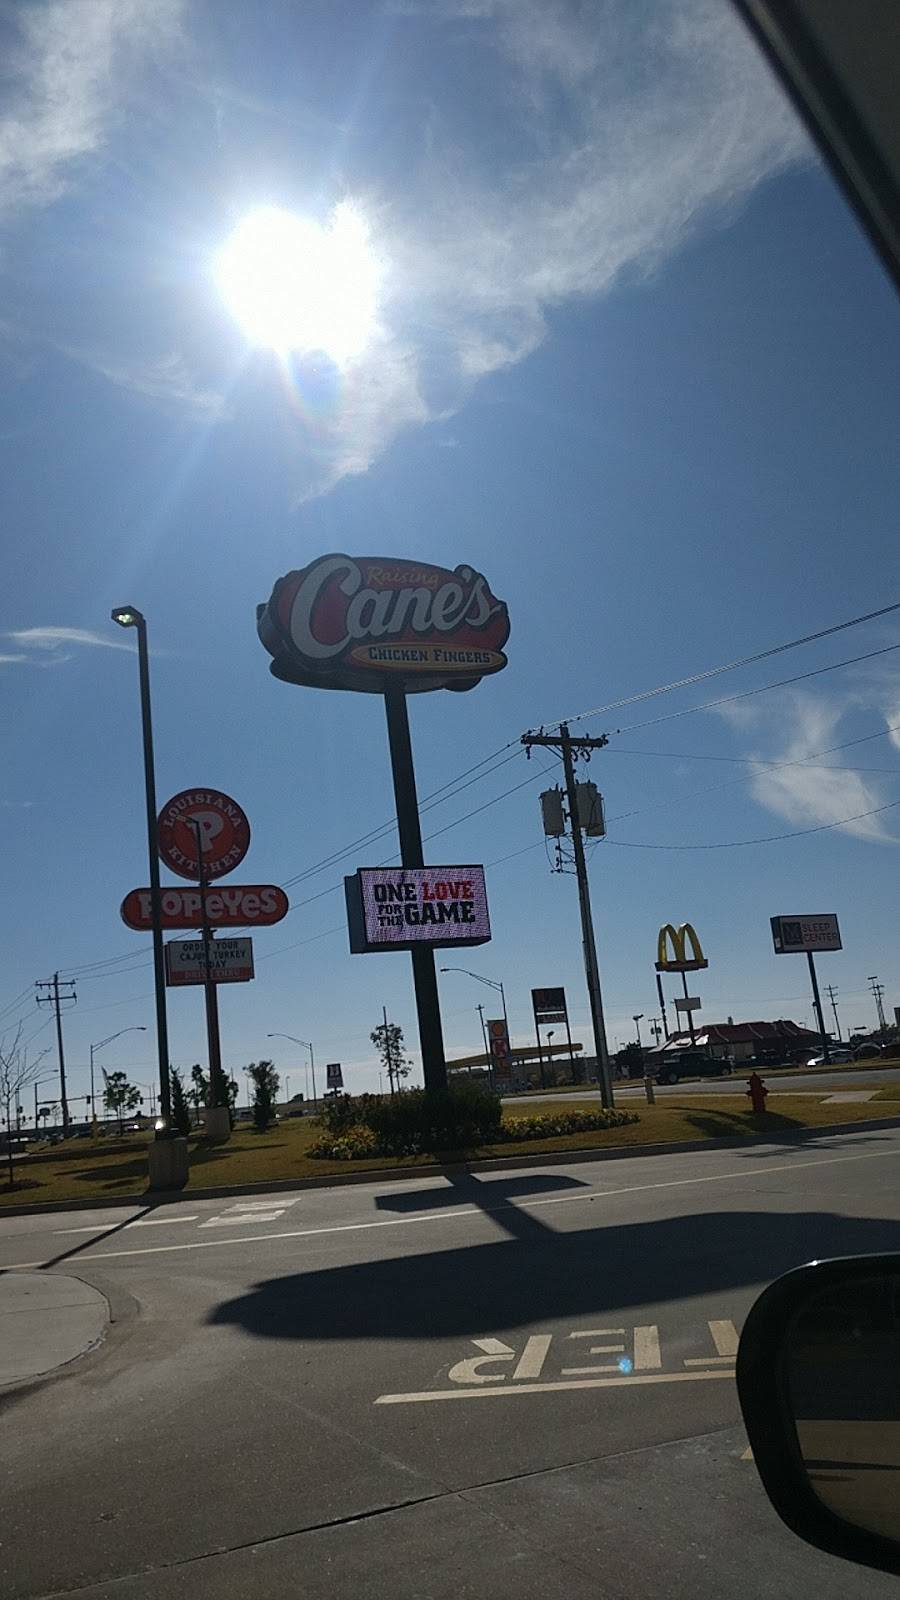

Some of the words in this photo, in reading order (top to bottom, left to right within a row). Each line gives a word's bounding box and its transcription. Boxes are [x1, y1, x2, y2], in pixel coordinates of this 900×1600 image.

[366, 565, 441, 591] Raising
[290, 557, 503, 659] Cane's
[368, 646, 430, 663] CHICKEN
[434, 648, 492, 664] FINGERS
[163, 794, 241, 828] LOUISIANA
[168, 844, 241, 873] KITCHEN
[373, 882, 417, 903] ONE
[422, 880, 475, 901] LOVE
[378, 904, 402, 916] FOR
[404, 900, 476, 926] GAME
[378, 915, 403, 927] THE
[802, 922, 831, 933] SLEEP
[216, 941, 239, 950] YOUR
[803, 931, 837, 944] CENTER
[214, 949, 245, 960] TURKEY
